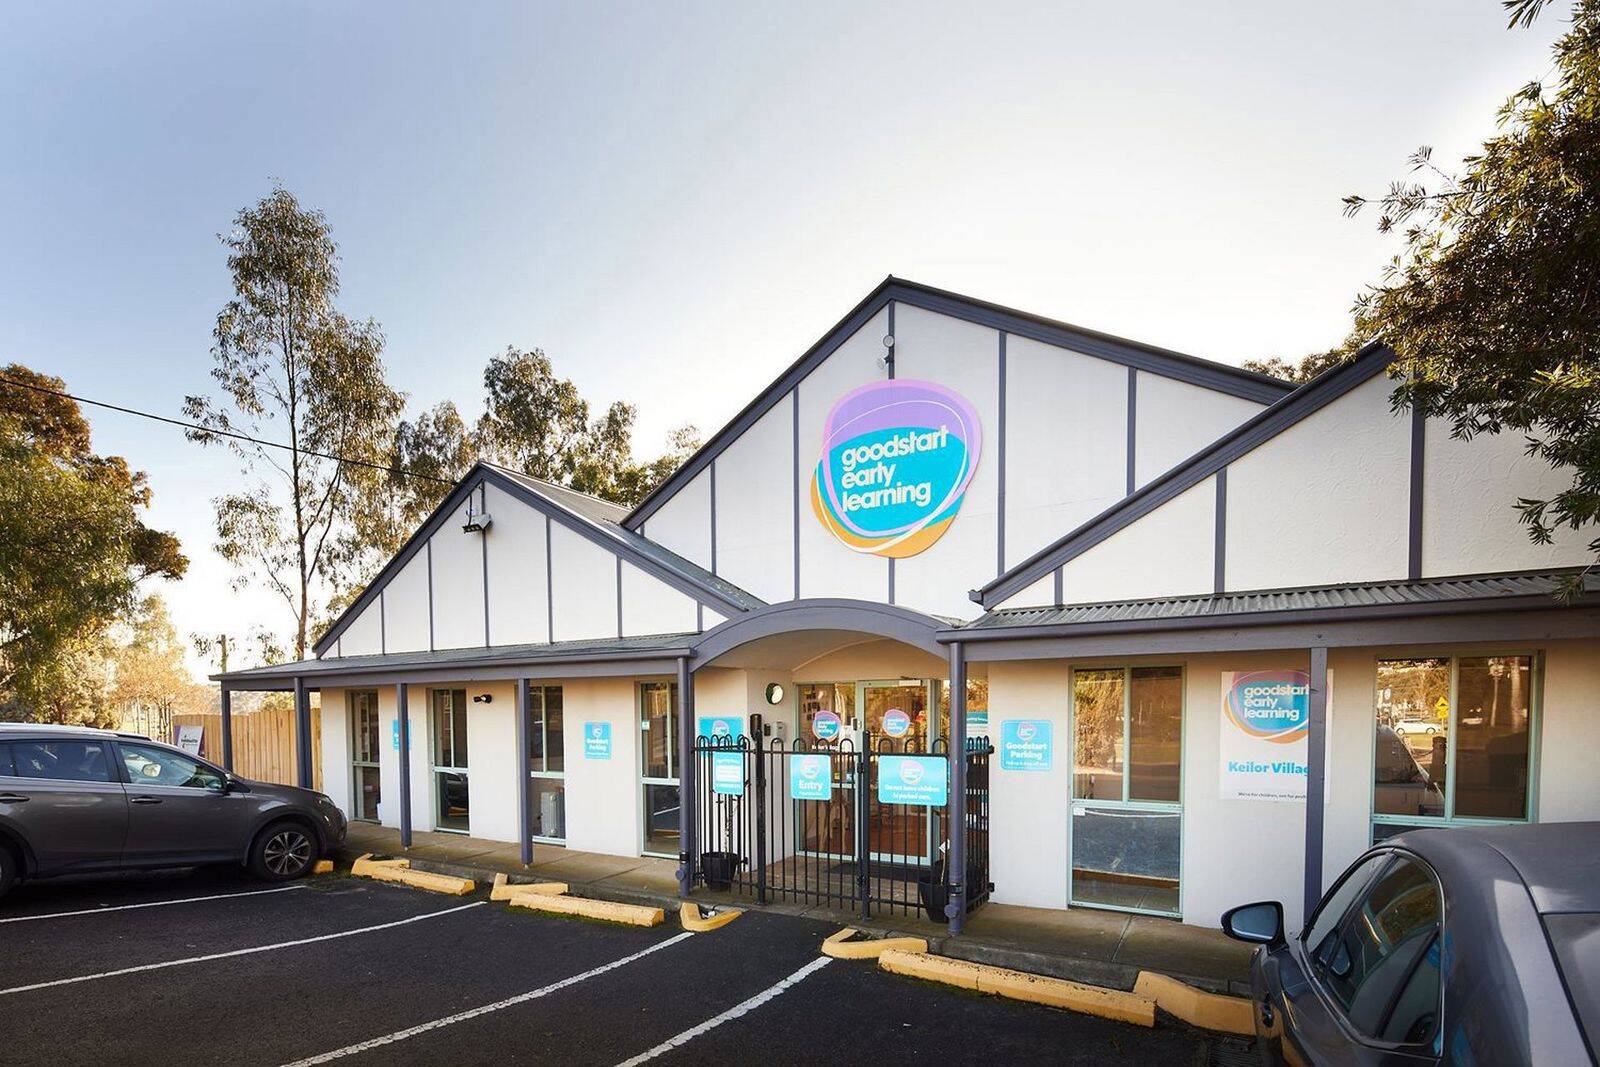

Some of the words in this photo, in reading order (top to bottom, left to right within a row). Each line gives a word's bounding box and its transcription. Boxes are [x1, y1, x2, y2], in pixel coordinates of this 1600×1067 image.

[841, 424, 949, 471] goodstart
[841, 461, 896, 489] early
[842, 482, 931, 512] learning
[1244, 684, 1309, 699] goodstart
[1244, 696, 1278, 709] early
[1244, 707, 1300, 721] learning
[1006, 741, 1048, 750] Goodstart
[1010, 750, 1043, 760] Parking
[1228, 761, 1270, 773] Keilor
[1271, 762, 1308, 776] Villag
[799, 779, 823, 791] Entry
